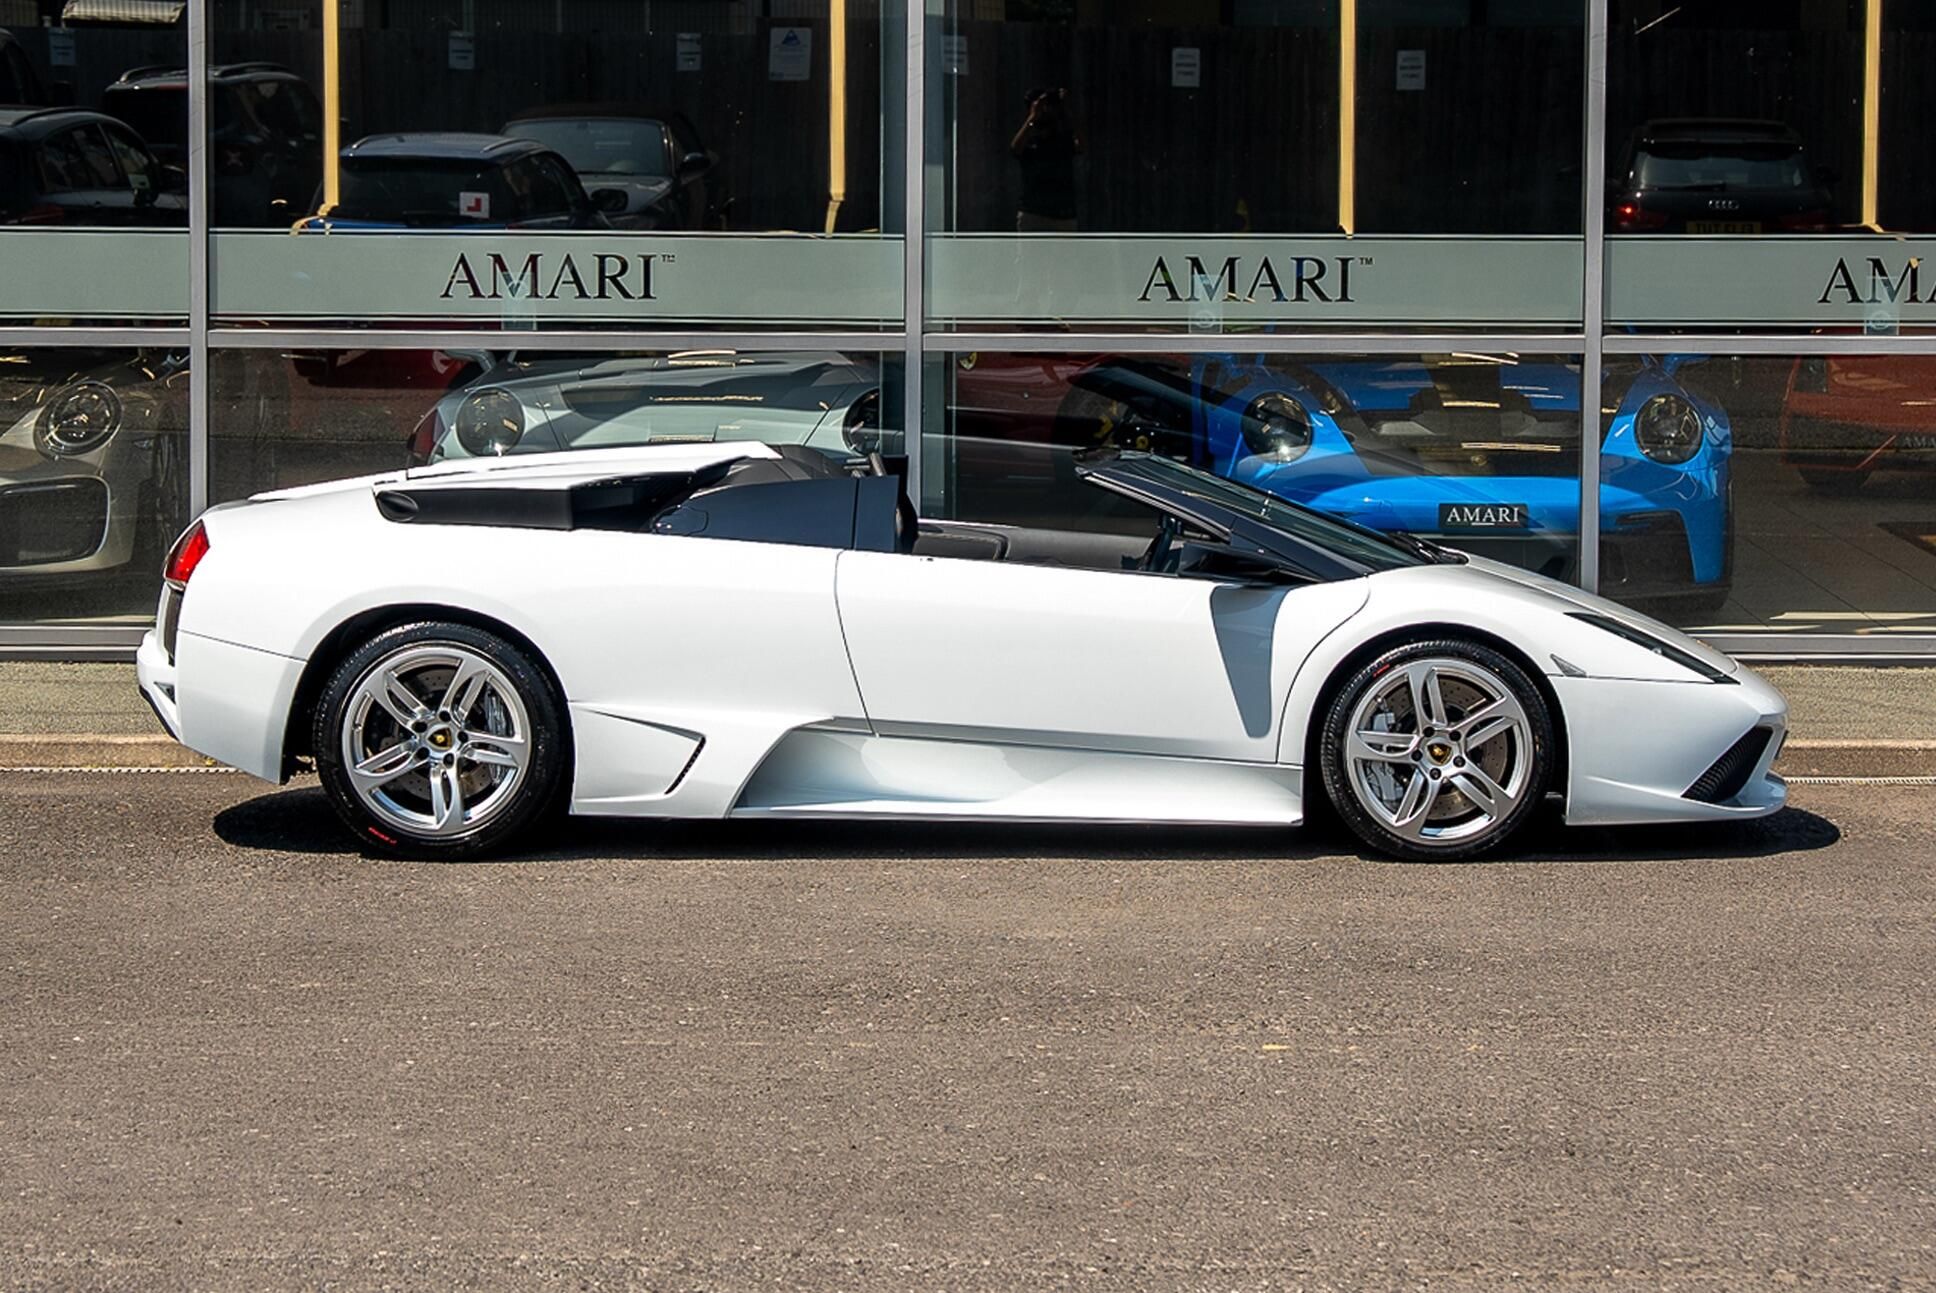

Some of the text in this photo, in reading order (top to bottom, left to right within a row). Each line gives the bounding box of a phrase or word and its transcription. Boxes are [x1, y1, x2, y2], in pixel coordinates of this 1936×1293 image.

[440, 252, 657, 299] AMARI
[1137, 255, 1354, 302] AMARI
[1817, 256, 1936, 303] AM
[1447, 506, 1519, 522] AMARI
